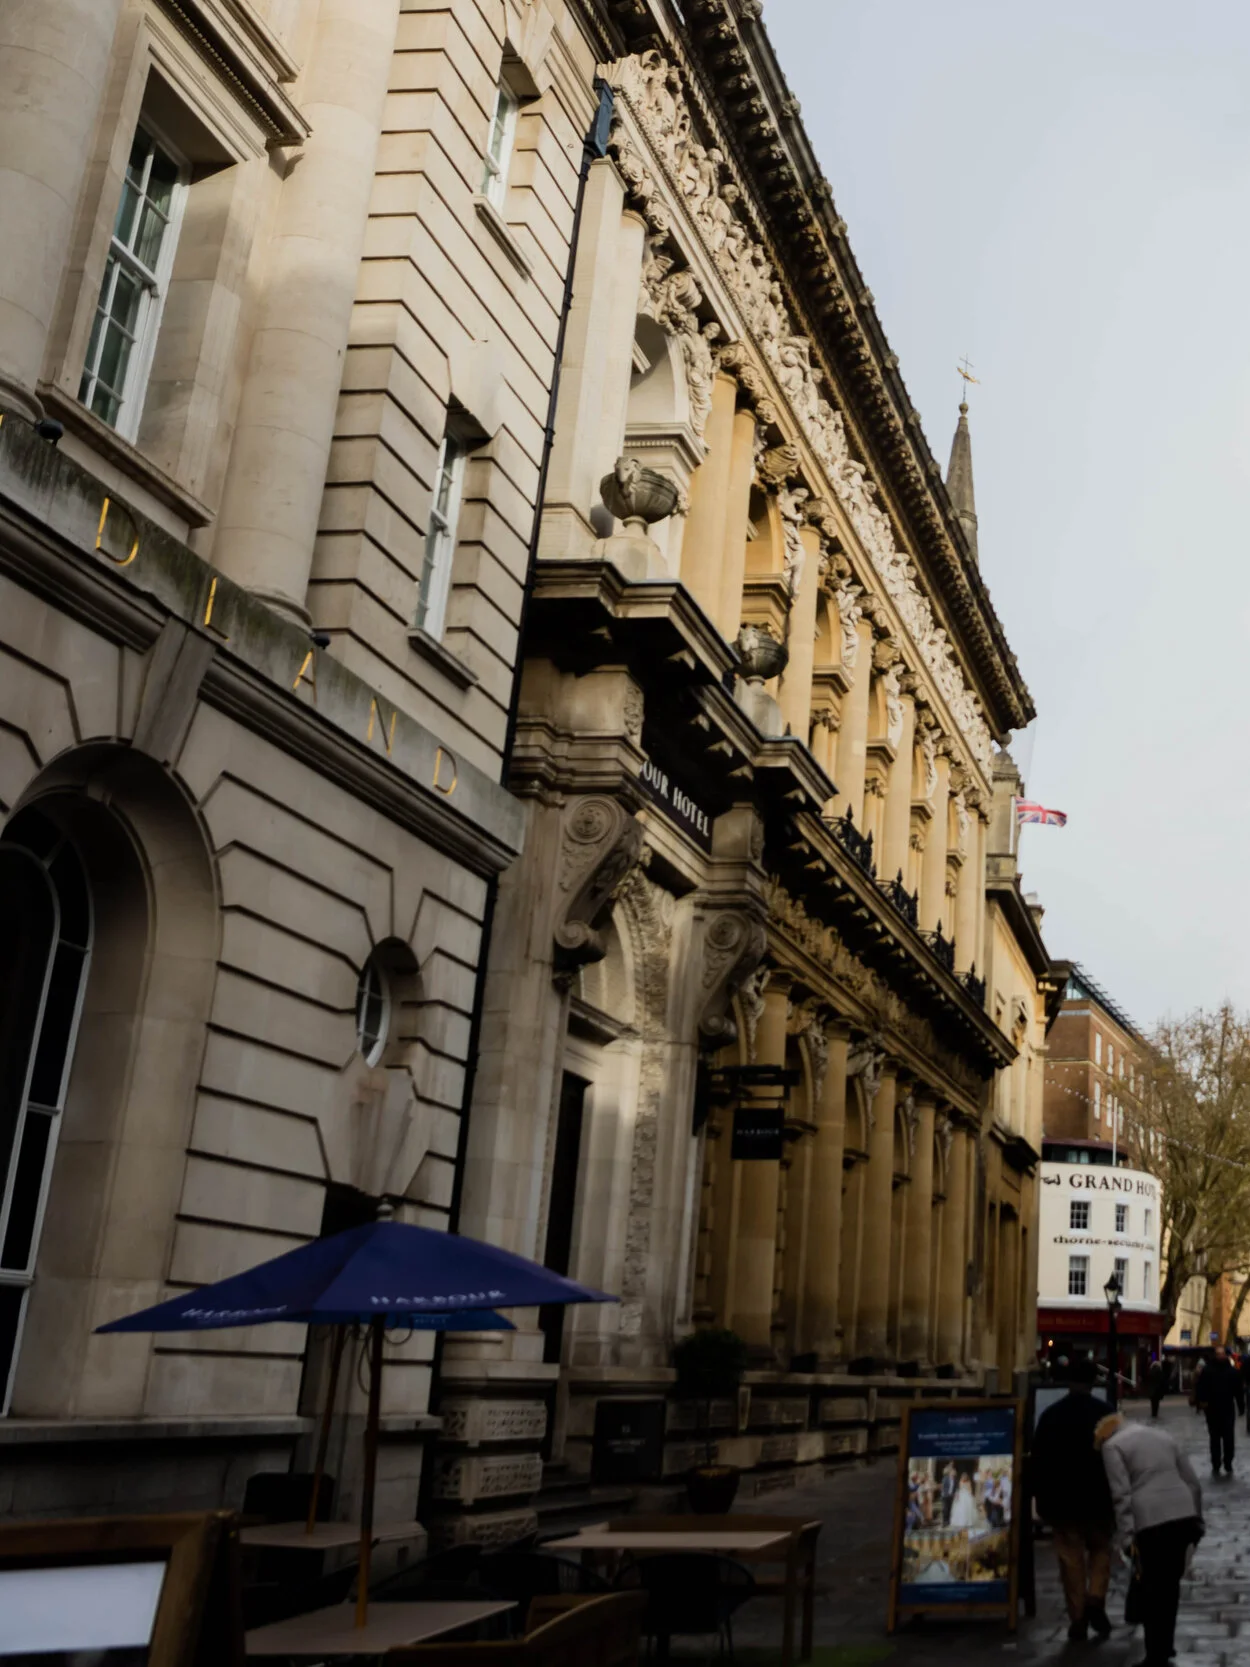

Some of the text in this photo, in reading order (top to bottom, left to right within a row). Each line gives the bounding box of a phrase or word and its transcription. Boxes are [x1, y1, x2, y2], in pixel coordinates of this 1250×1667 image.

[0, 412, 459, 797] DLAND
[640, 760, 709, 837] OUR HOTEL
[1069, 1173, 1133, 1192] GRAND
